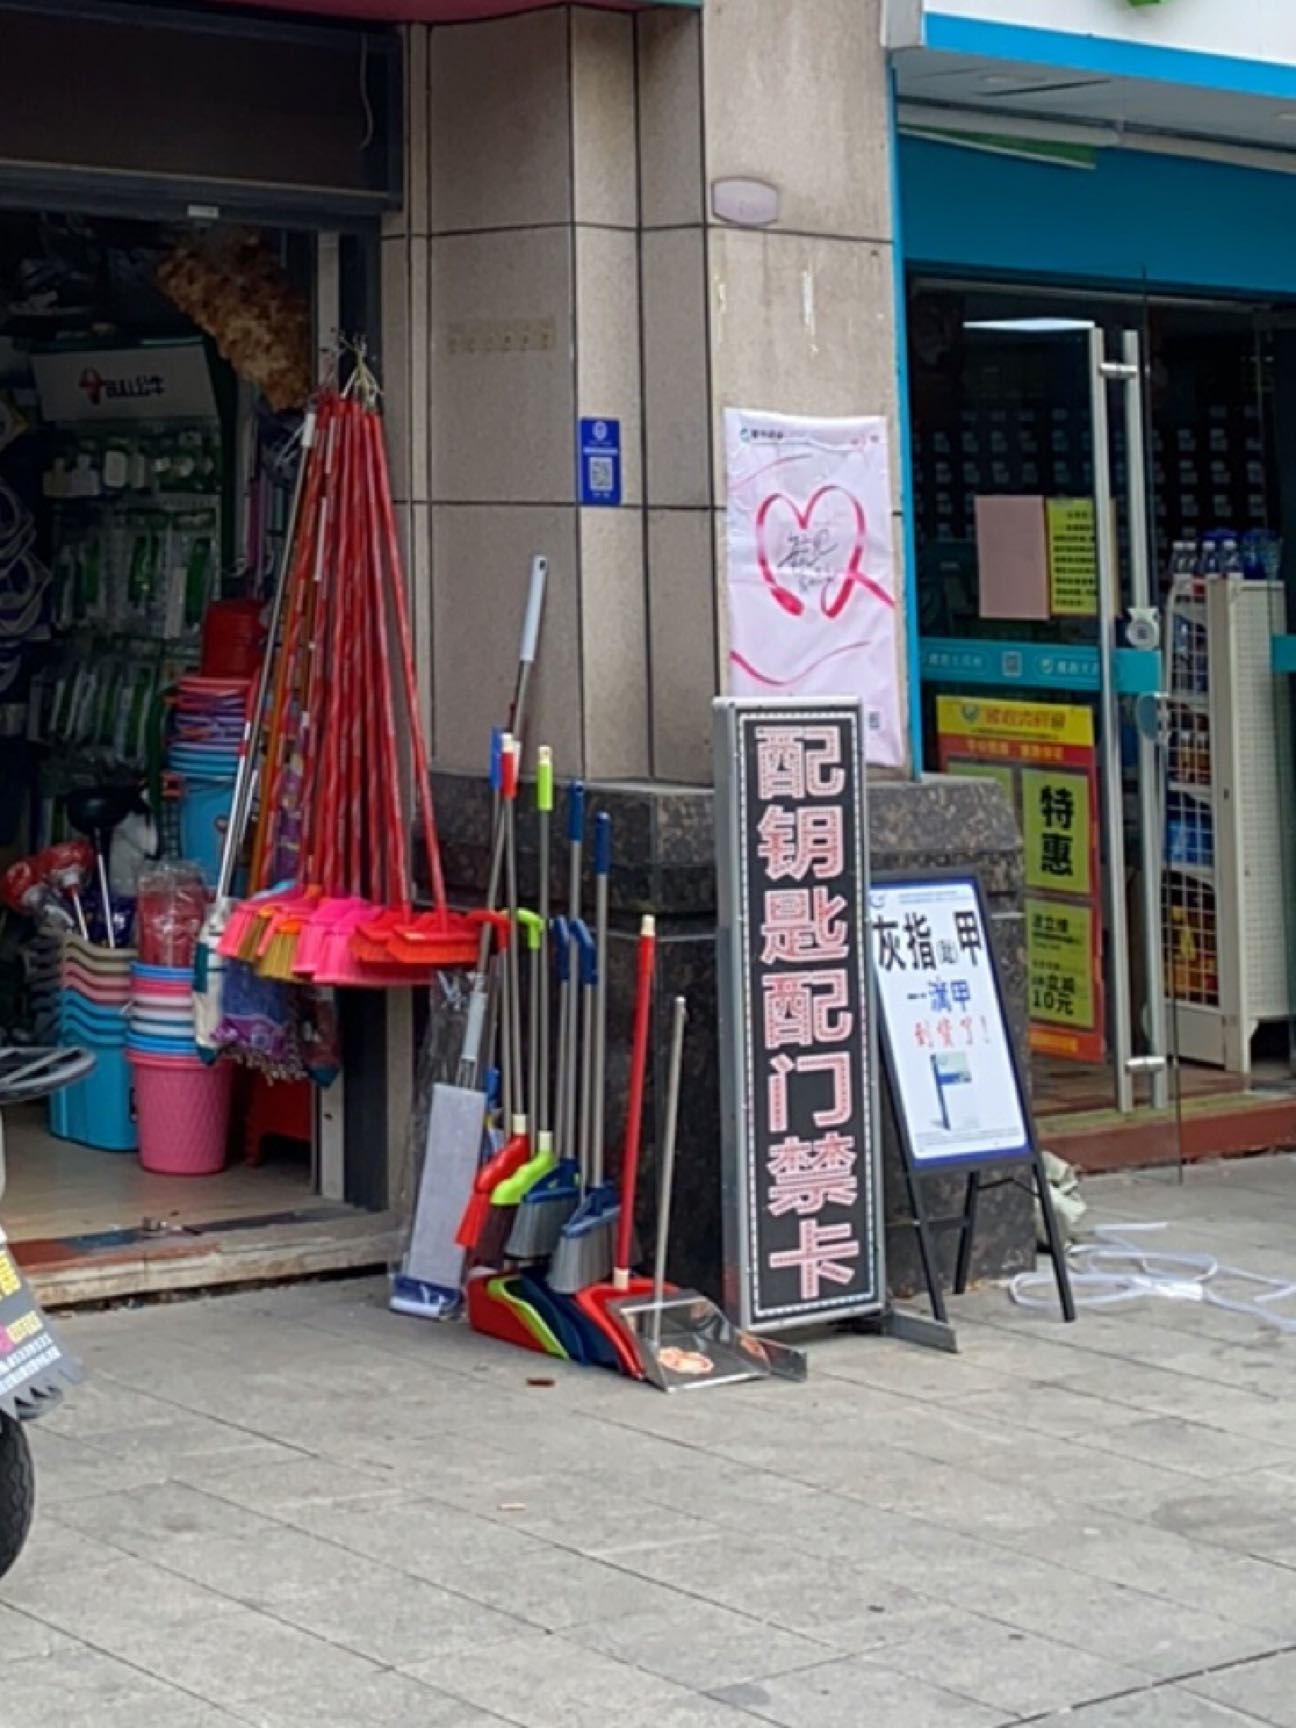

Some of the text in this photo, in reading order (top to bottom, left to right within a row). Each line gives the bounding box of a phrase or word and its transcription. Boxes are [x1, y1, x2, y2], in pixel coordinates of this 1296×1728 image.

[1039, 783, 1075, 878] 特惠
[755, 725, 860, 1300] 配钥匙配门禁卡
